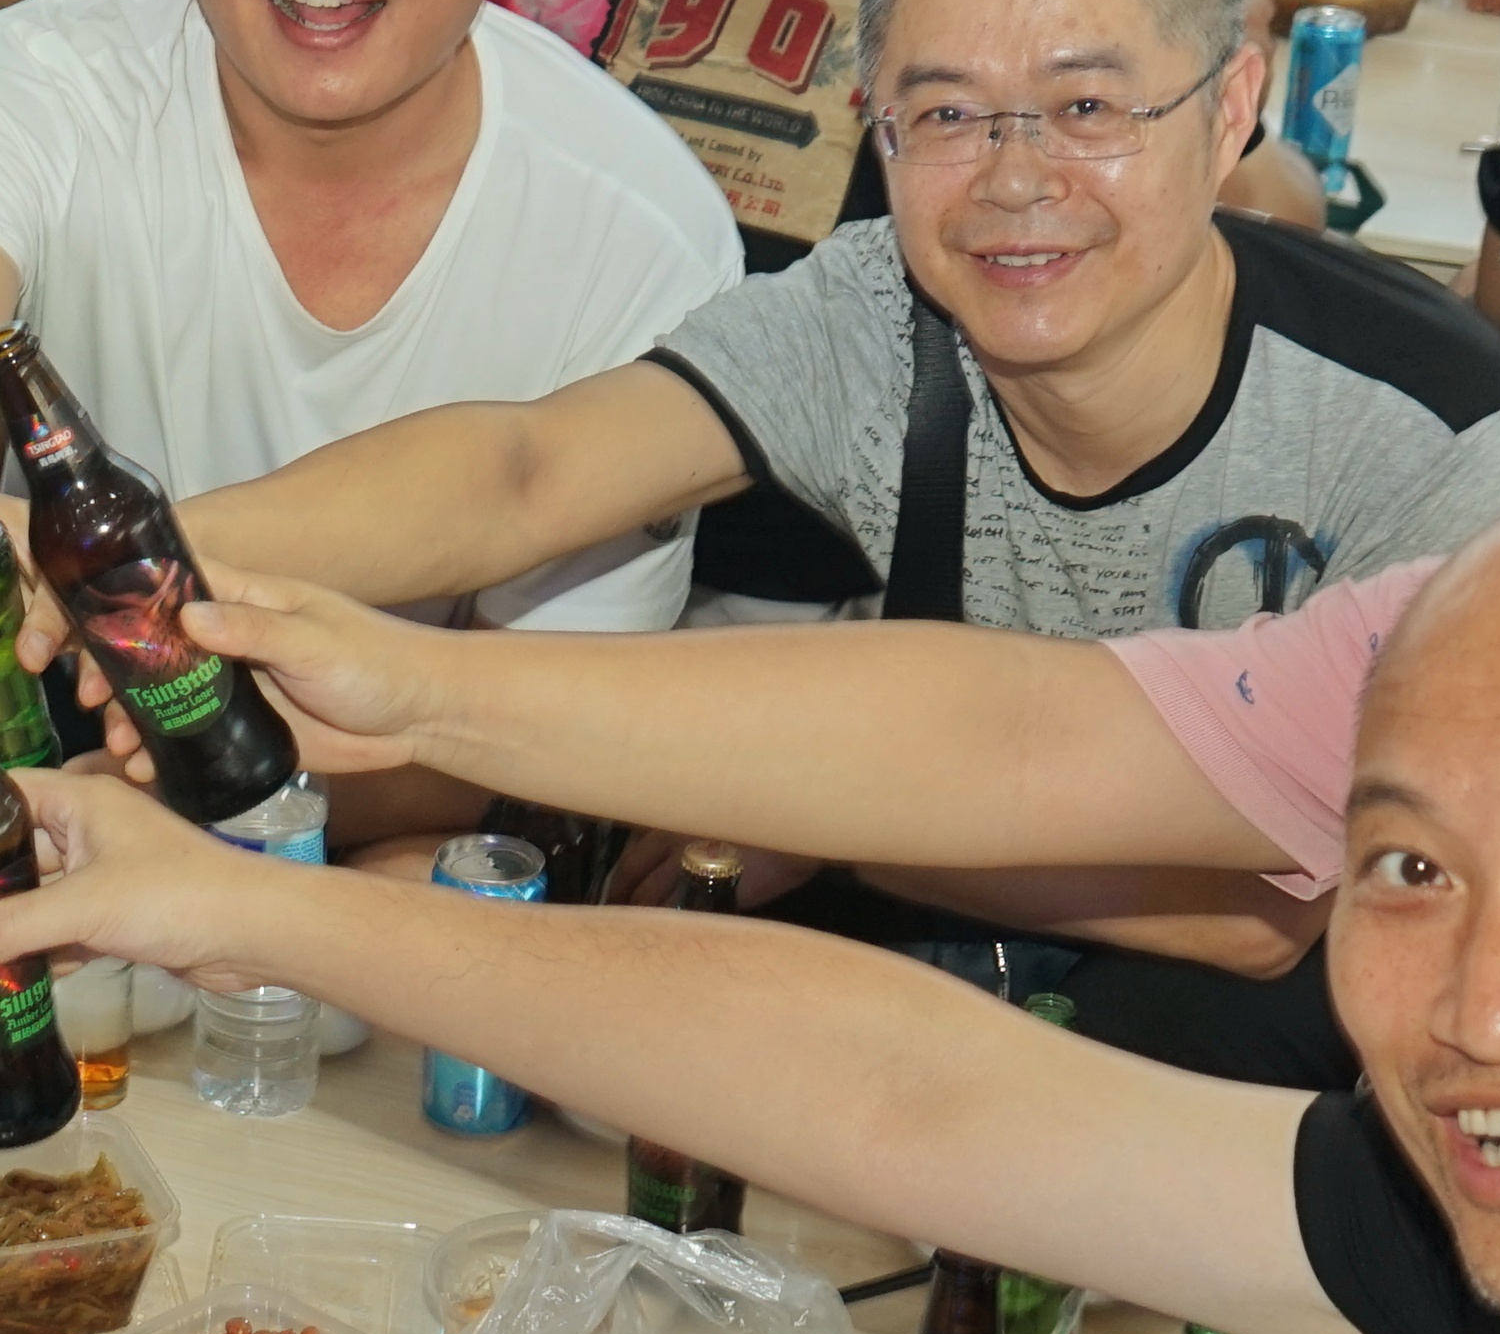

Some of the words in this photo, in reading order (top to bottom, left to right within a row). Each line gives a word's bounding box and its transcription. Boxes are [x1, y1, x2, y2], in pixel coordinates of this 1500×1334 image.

[28, 430, 72, 456] TSINGTAO
[126, 654, 223, 709] Tsingtao
[153, 699, 188, 721] Amber
